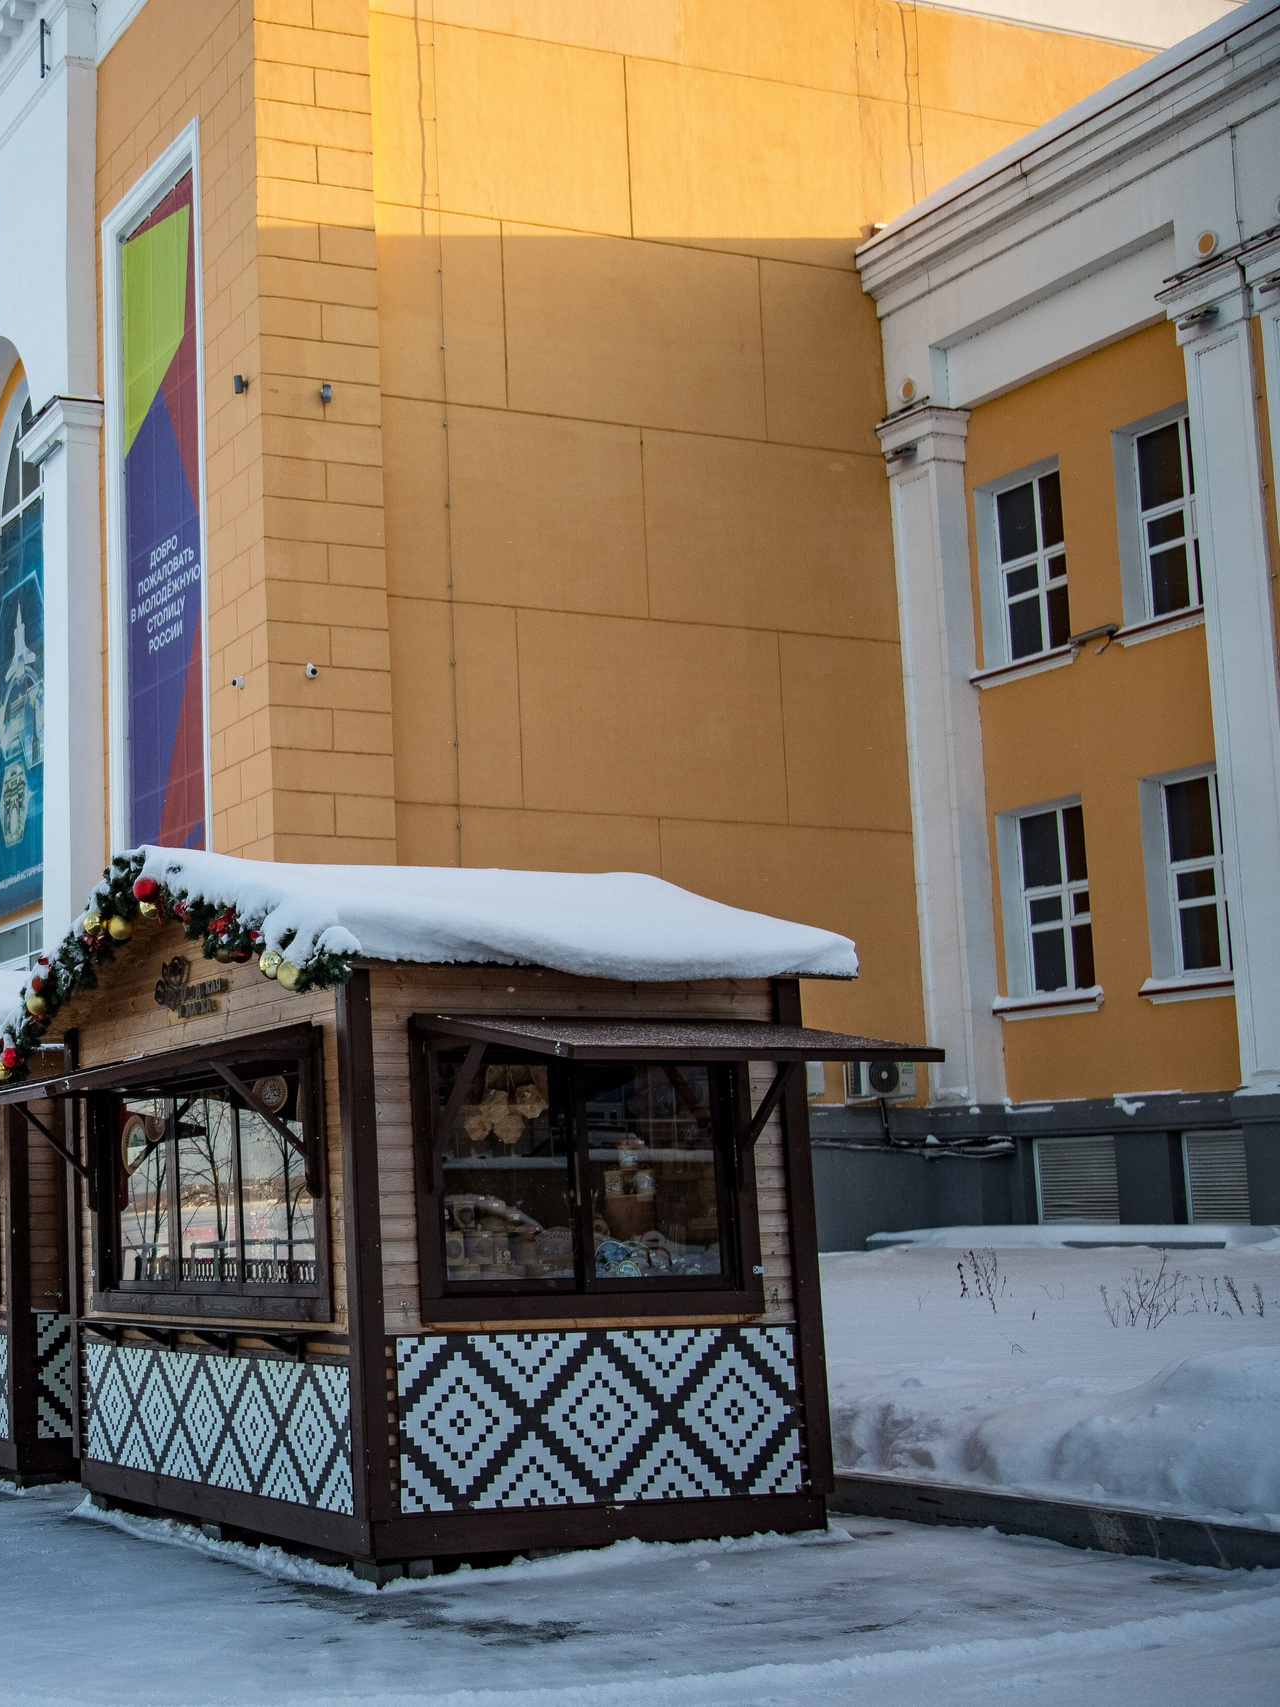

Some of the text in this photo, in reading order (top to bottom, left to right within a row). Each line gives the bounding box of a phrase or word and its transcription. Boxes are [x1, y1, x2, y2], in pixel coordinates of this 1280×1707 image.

[149, 534, 178, 570] ДОБРО
[138, 546, 195, 597] ПОЖАЛОВАТЬ
[131, 563, 201, 623] В МОЛОДЁЖНУЮ
[147, 595, 185, 633] СТОЛИЦУ
[148, 620, 183, 655] РОССИИ
